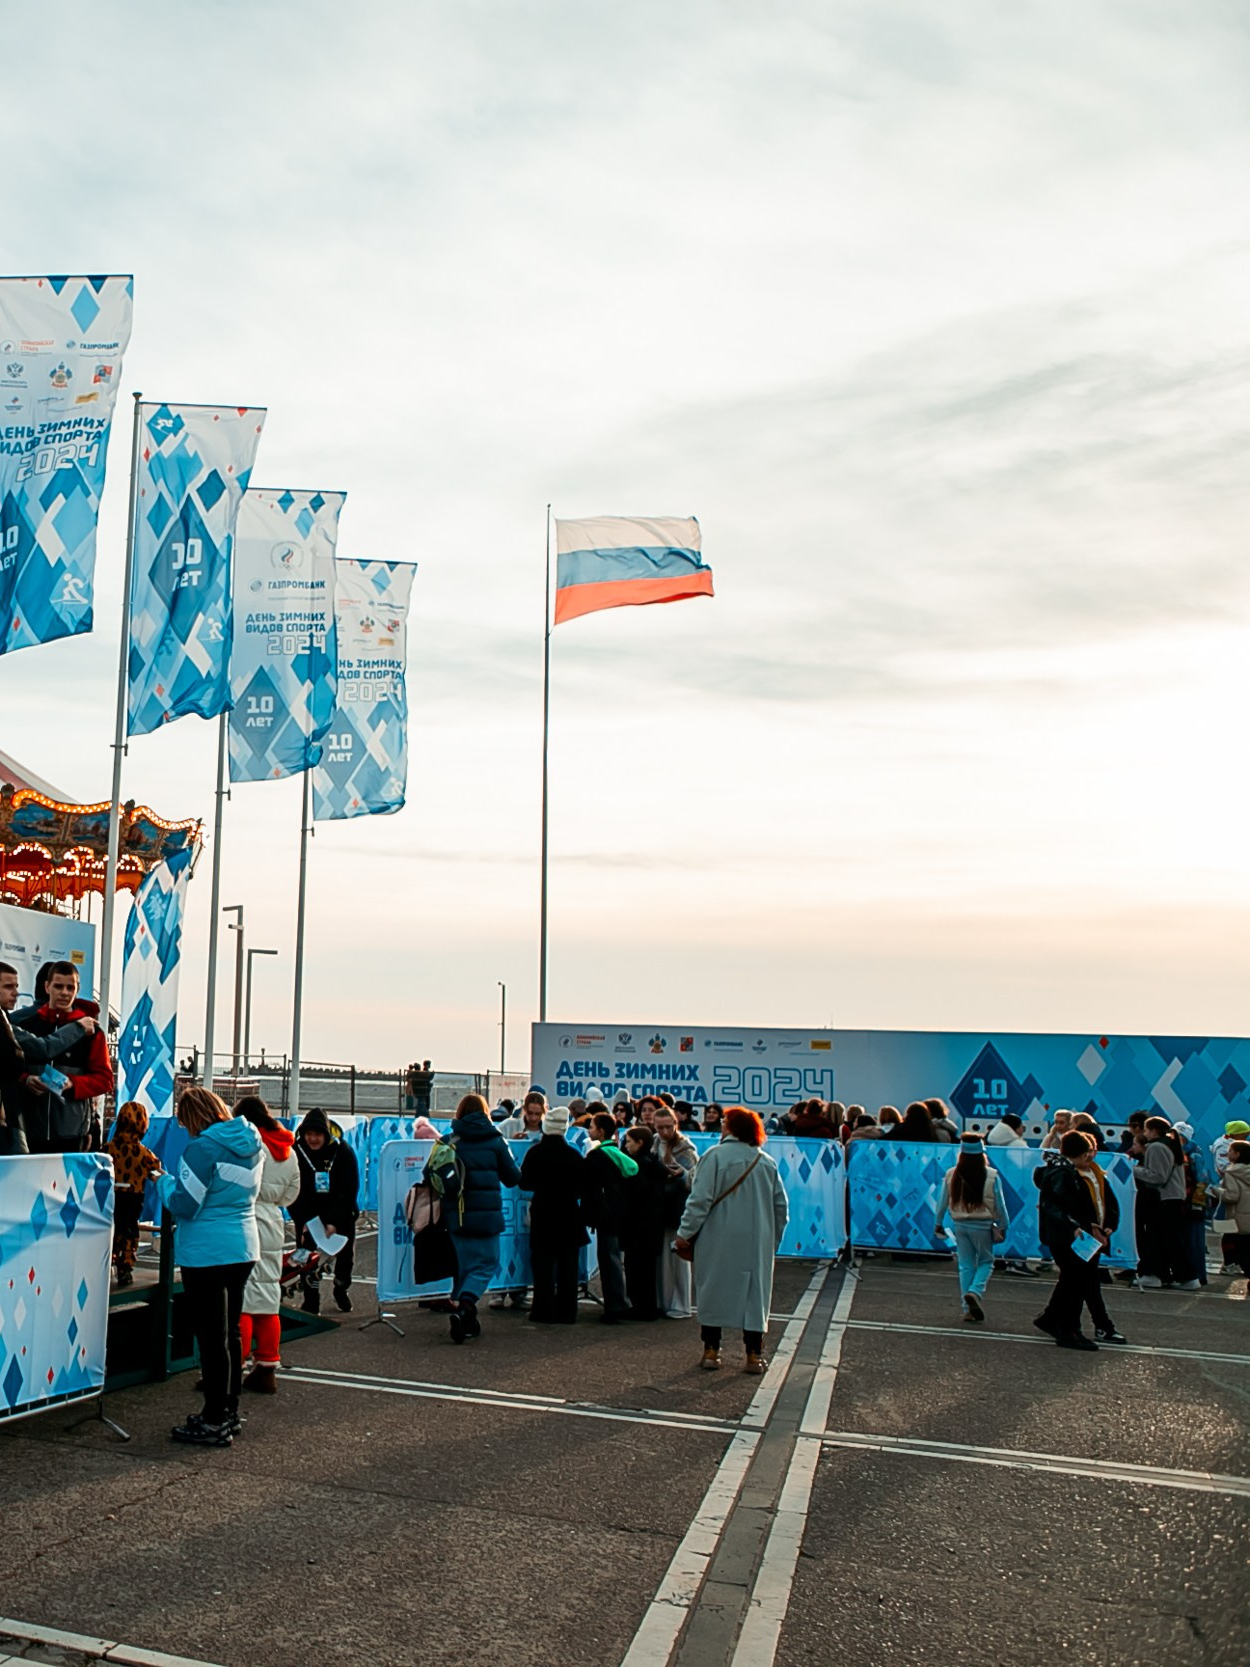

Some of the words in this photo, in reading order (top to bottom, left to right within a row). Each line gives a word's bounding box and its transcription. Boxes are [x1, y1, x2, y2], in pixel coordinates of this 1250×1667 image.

[37, 417, 106, 435] ЗИМНИХ
[44, 429, 103, 445] СПОРТА
[15, 443, 100, 483] 2024
[172, 538, 203, 570] 10
[268, 580, 326, 590] ГАЗПРОМБАНК
[246, 612, 276, 624] ДЕНЬ
[279, 612, 326, 622] ЗИМНИХ
[245, 623, 284, 634] ВИДОВ
[286, 623, 326, 633] СПОРТА
[267, 635, 327, 655] 2024
[338, 659, 354, 669] НЬ
[356, 659, 403, 670] ЗИМНИХ
[338, 670, 361, 681] ДОВ
[363, 670, 404, 680] СПОРТА
[344, 682, 404, 703] 2024
[247, 696, 274, 714] 10
[328, 733, 352, 750] 10
[556, 1061, 611, 1079] ДЕНЬ
[614, 1062, 700, 1081] ЗИМНИХ
[631, 1083, 708, 1102] СПОРТА
[712, 1066, 834, 1106] 2024
[973, 1078, 1007, 1099] 10
